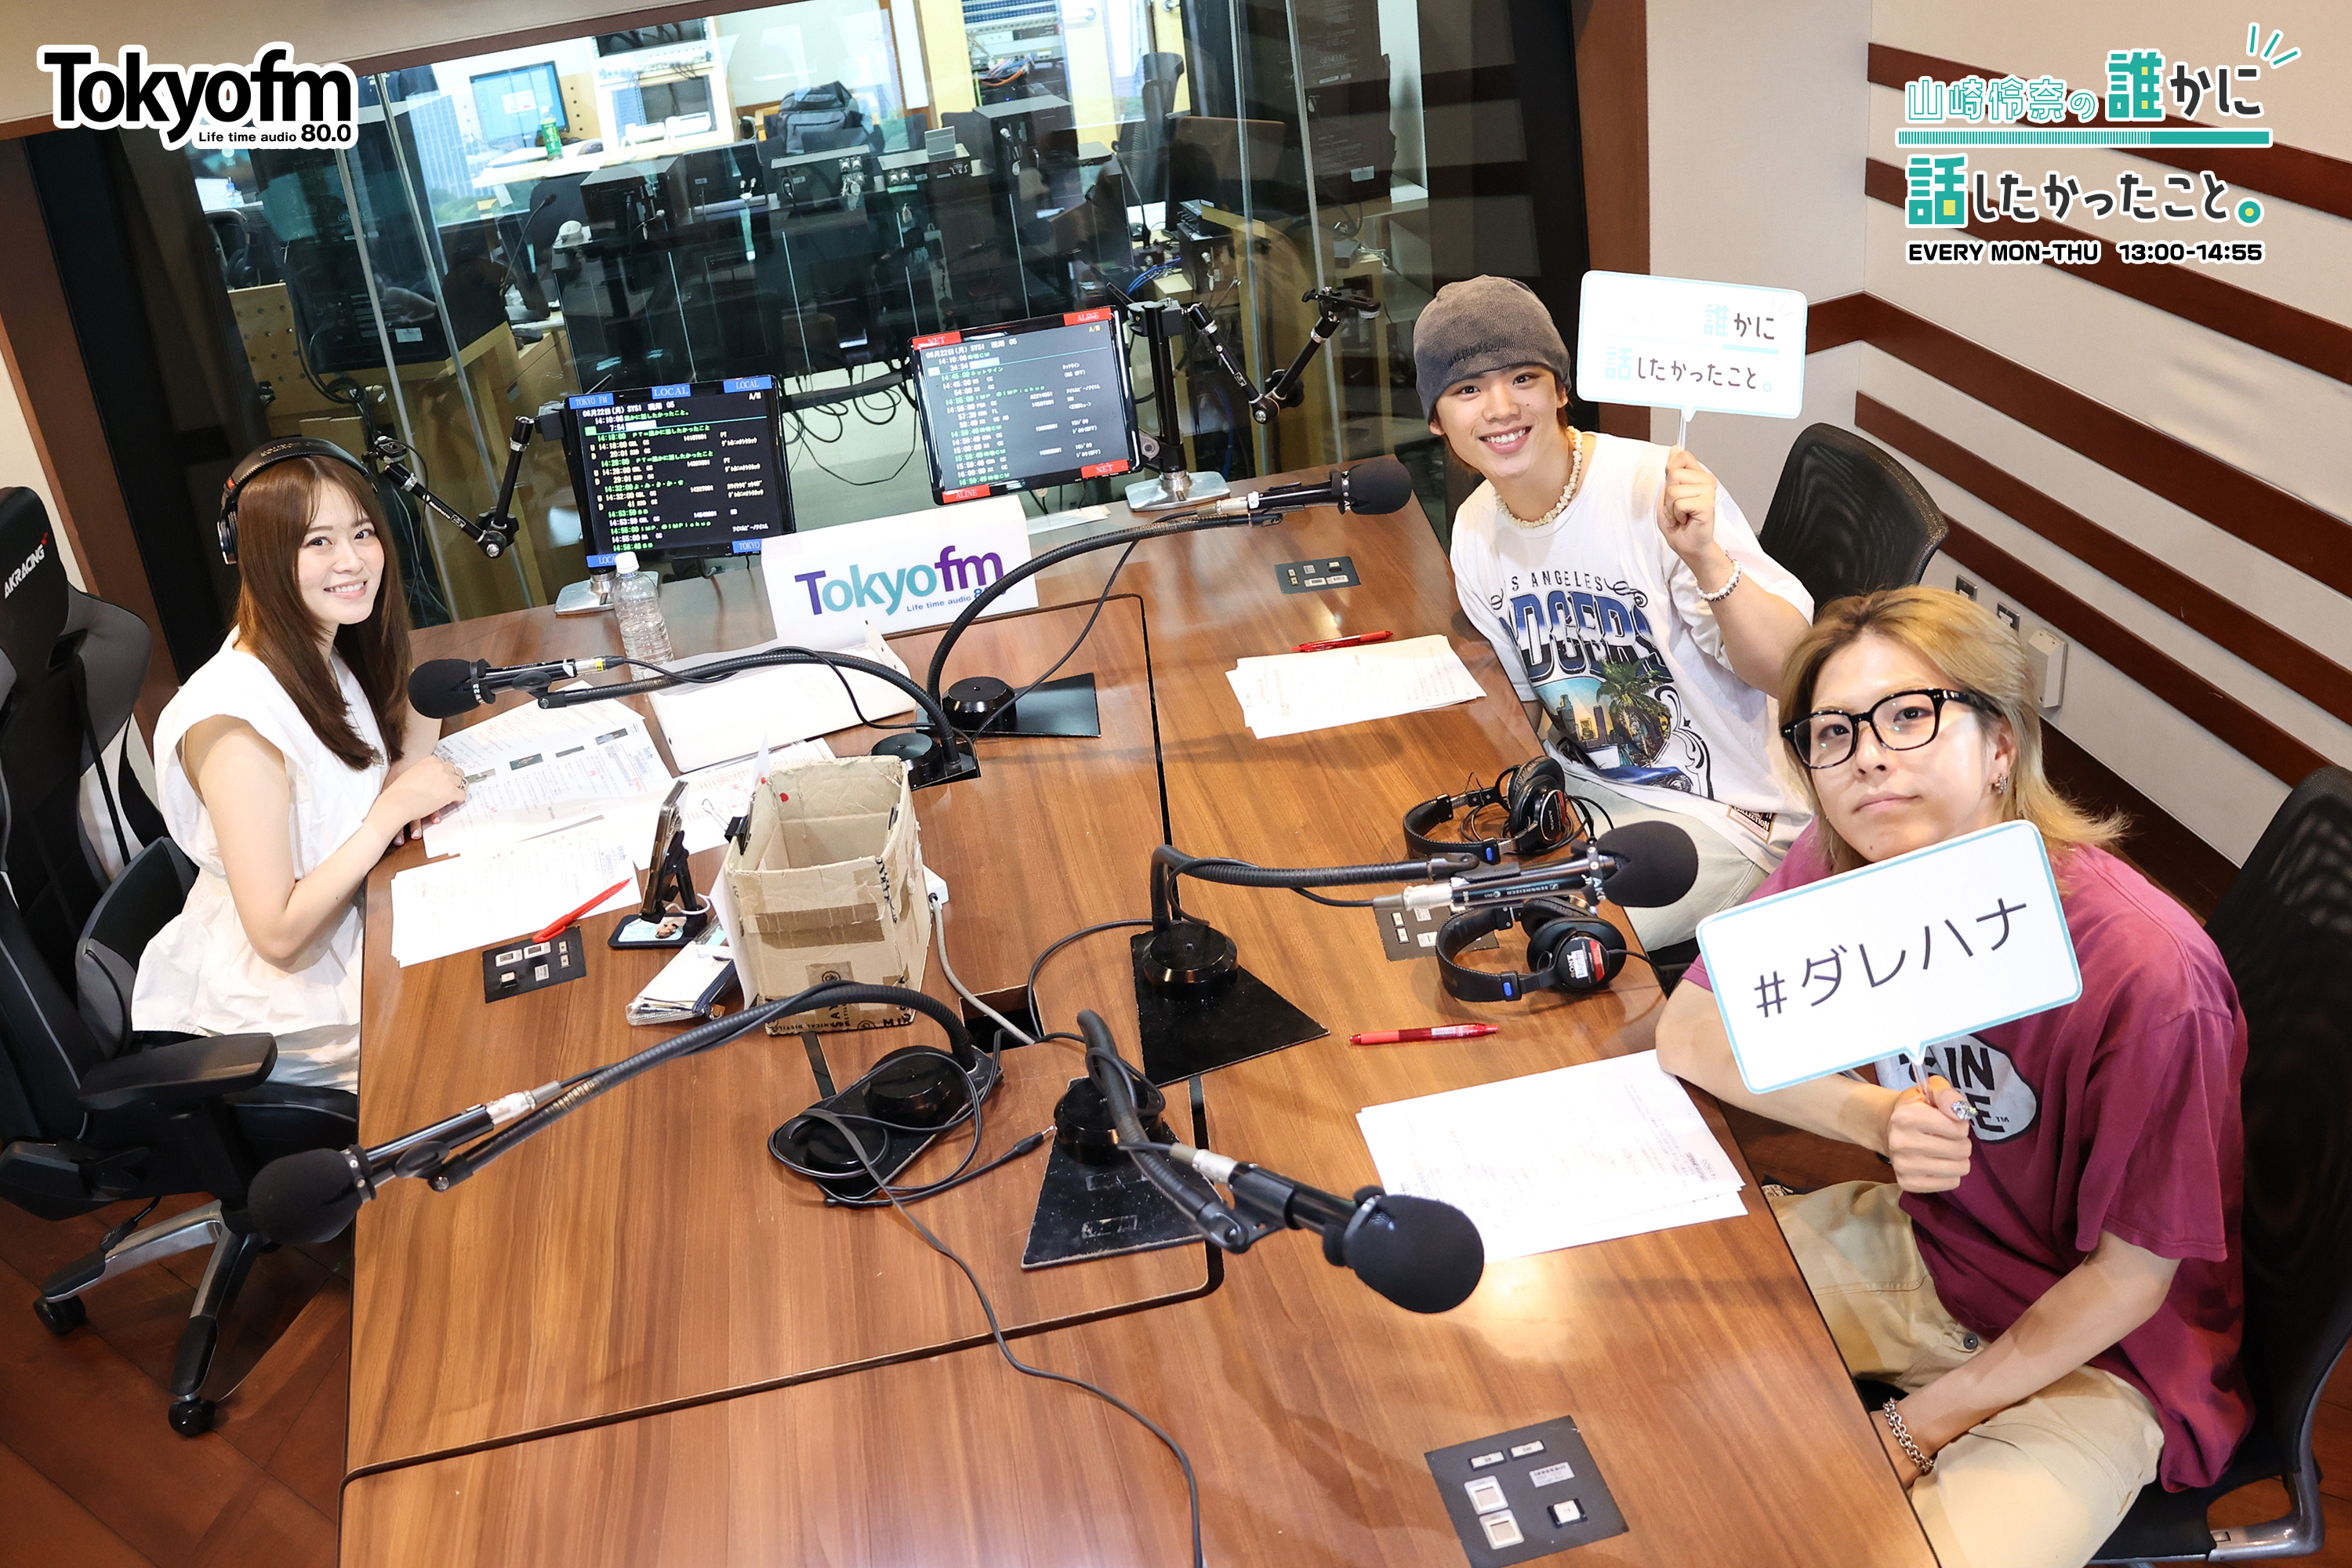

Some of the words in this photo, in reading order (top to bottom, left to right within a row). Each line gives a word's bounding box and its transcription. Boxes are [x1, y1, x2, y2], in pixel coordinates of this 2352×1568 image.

[1077, 312, 1100, 322] ALINE
[1704, 304, 1775, 340] 誰かに
[927, 336, 946, 345] NET
[949, 362, 969, 372] 34:54
[1605, 347, 1773, 393] 話したかったこと。
[942, 371, 970, 382] 14:45:00
[735, 380, 759, 390] LOCAL
[942, 379, 971, 390] 14:45:00
[654, 387, 688, 397] LOCAL
[953, 387, 973, 397] 54:00
[575, 397, 596, 407] TOKYO
[946, 396, 974, 406] 14:55:00
[947, 404, 975, 415] 14:55:00
[598, 441, 627, 451] 14:18:00
[953, 444, 982, 454] 15:00:00
[957, 467, 986, 478] 16:00:00
[1096, 464, 1113, 474] NET
[604, 484, 633, 493] 14:32:00
[605, 492, 635, 502] 14:32:00
[956, 489, 978, 500] ALINE
[611, 526, 640, 535] 14:55:00
[612, 534, 641, 543] 14:55:00
[739, 541, 760, 550] TOKYO
[4, 544, 45, 600] AKRACING
[794, 545, 1004, 616] Tokyofm
[1531, 570, 1603, 591] ANGELES
[906, 604, 924, 612] Life
[926, 599, 946, 610] time
[948, 594, 972, 606] audio
[1754, 898, 2027, 1018] #ダレハナ
